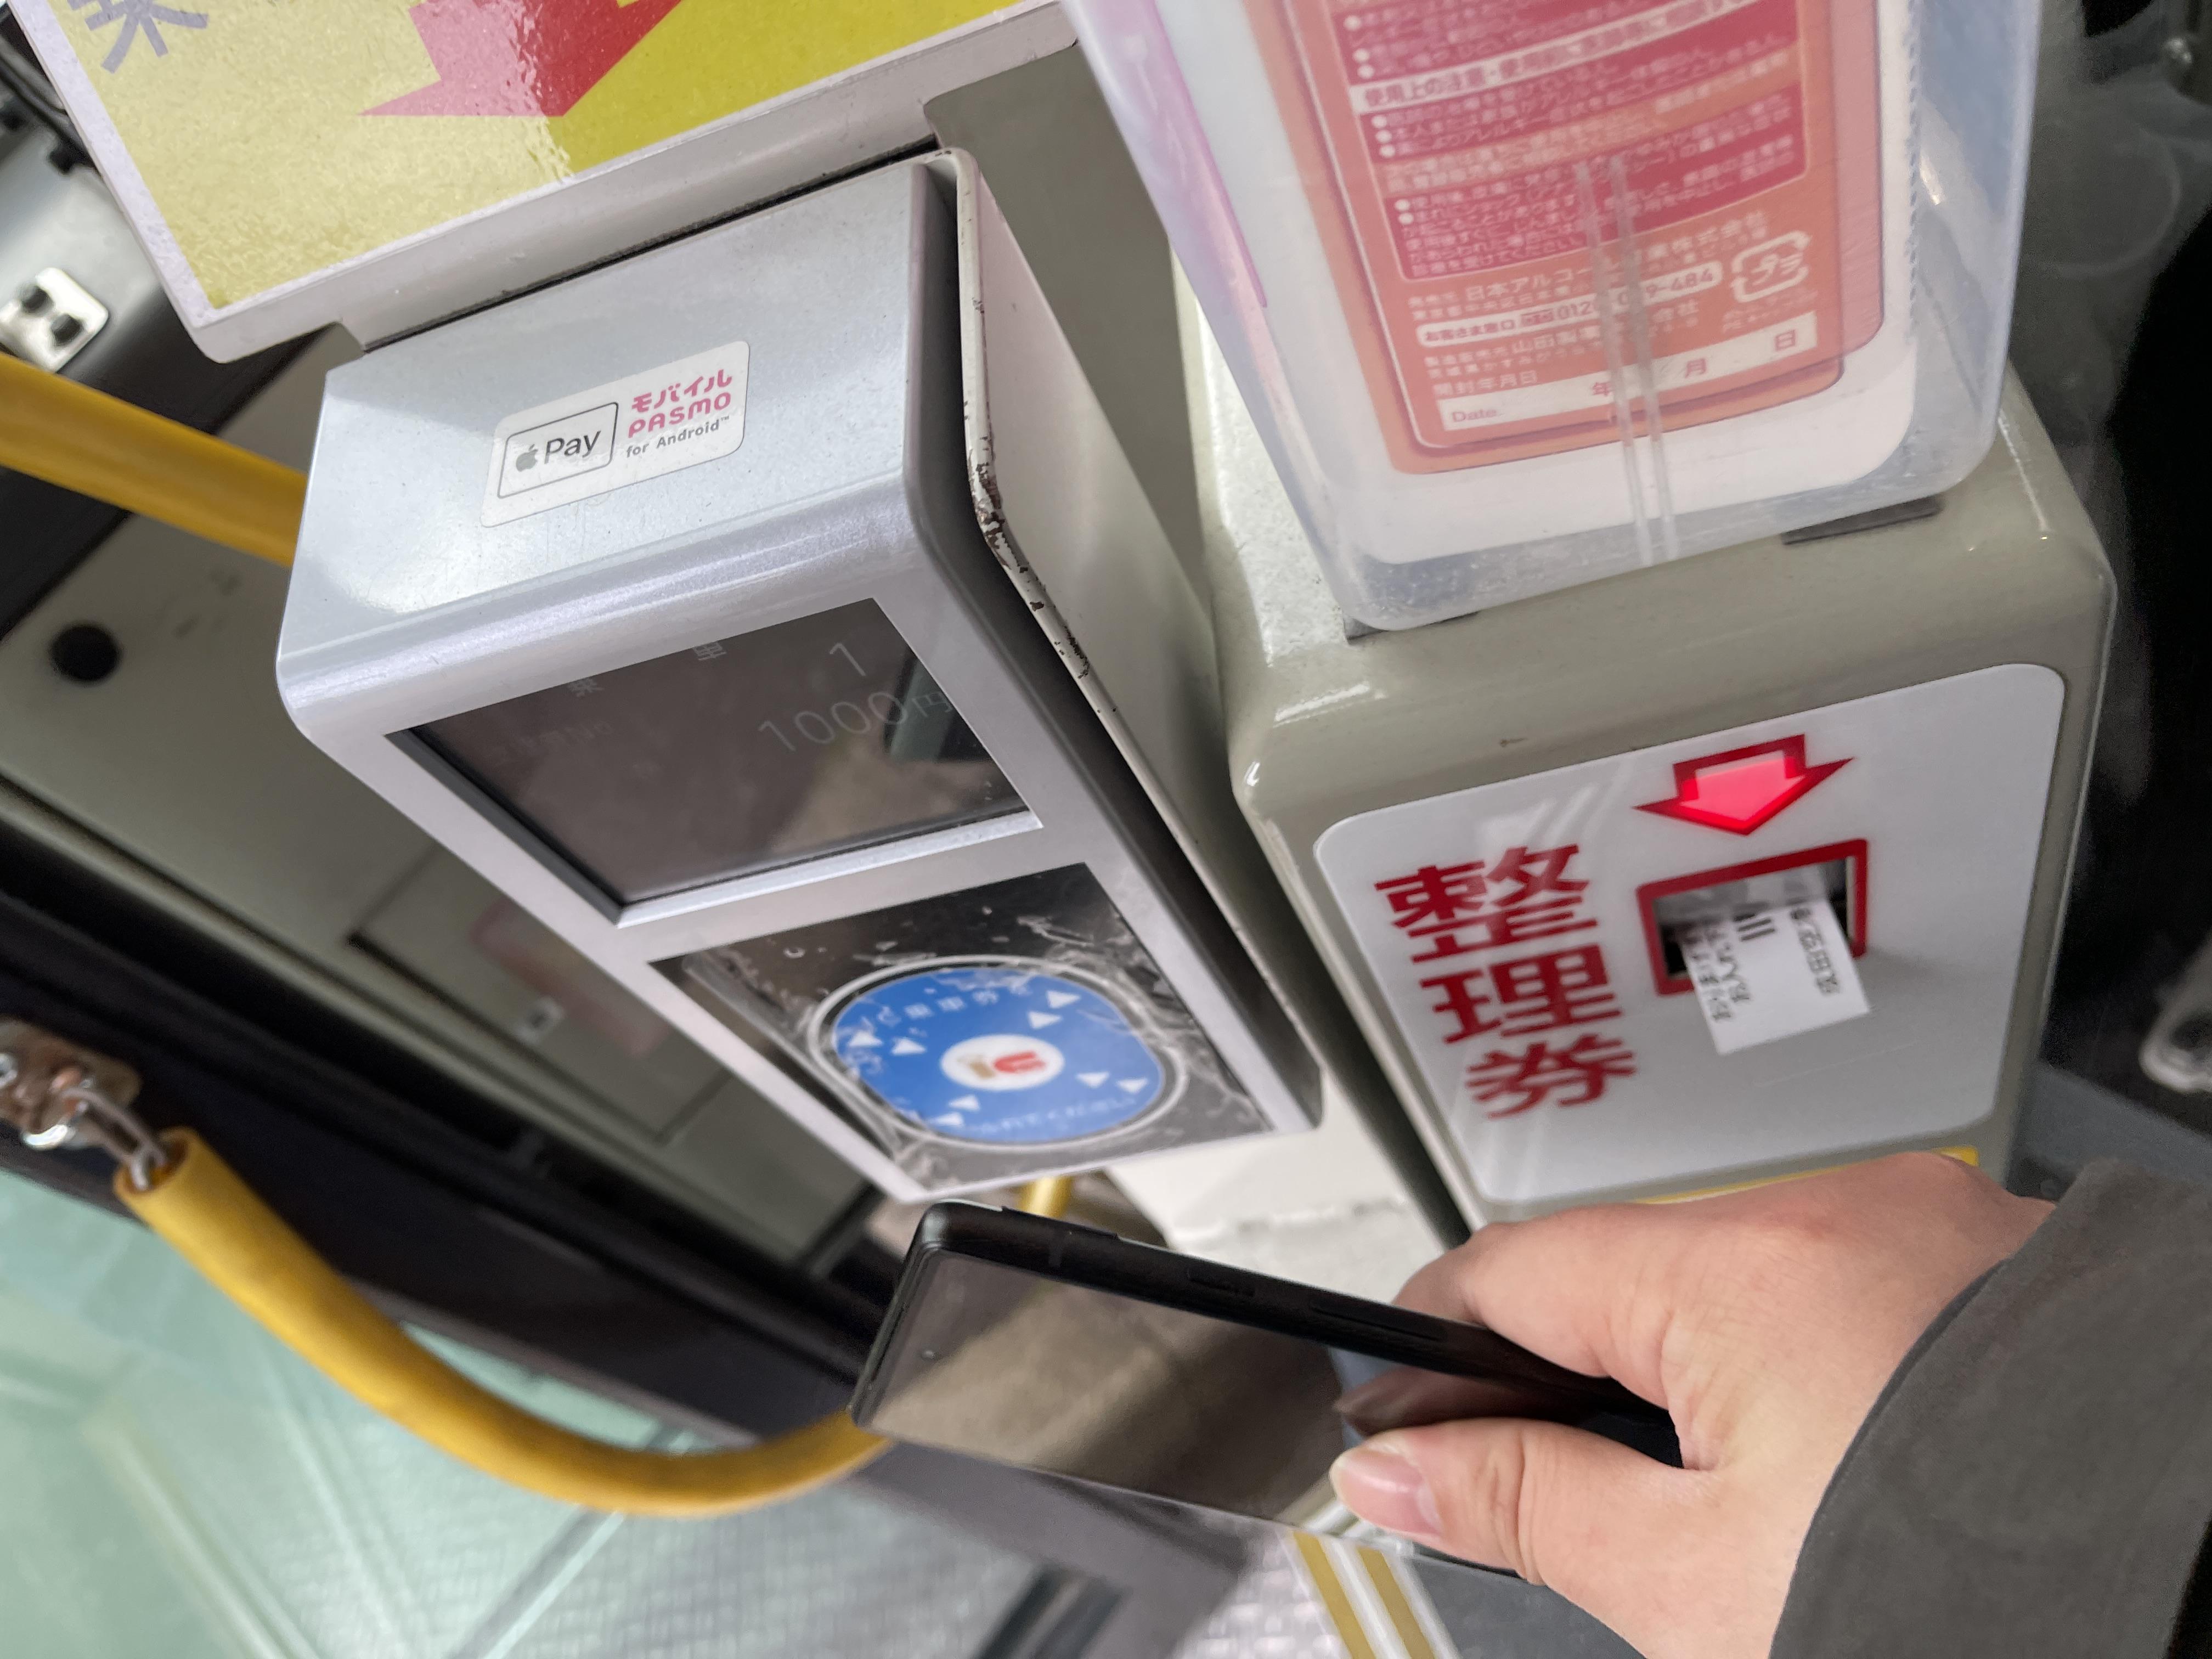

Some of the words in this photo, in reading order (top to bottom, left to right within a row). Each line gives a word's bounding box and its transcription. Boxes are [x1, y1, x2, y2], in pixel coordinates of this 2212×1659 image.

[1685, 358, 1707, 379] 月
[1774, 329, 1797, 352] 日
[631, 369, 732, 411] モバイル
[628, 392, 731, 438] PASMO
[544, 430, 601, 464] Pay
[627, 443, 647, 458] for
[1375, 842, 1637, 1119] 整理券
